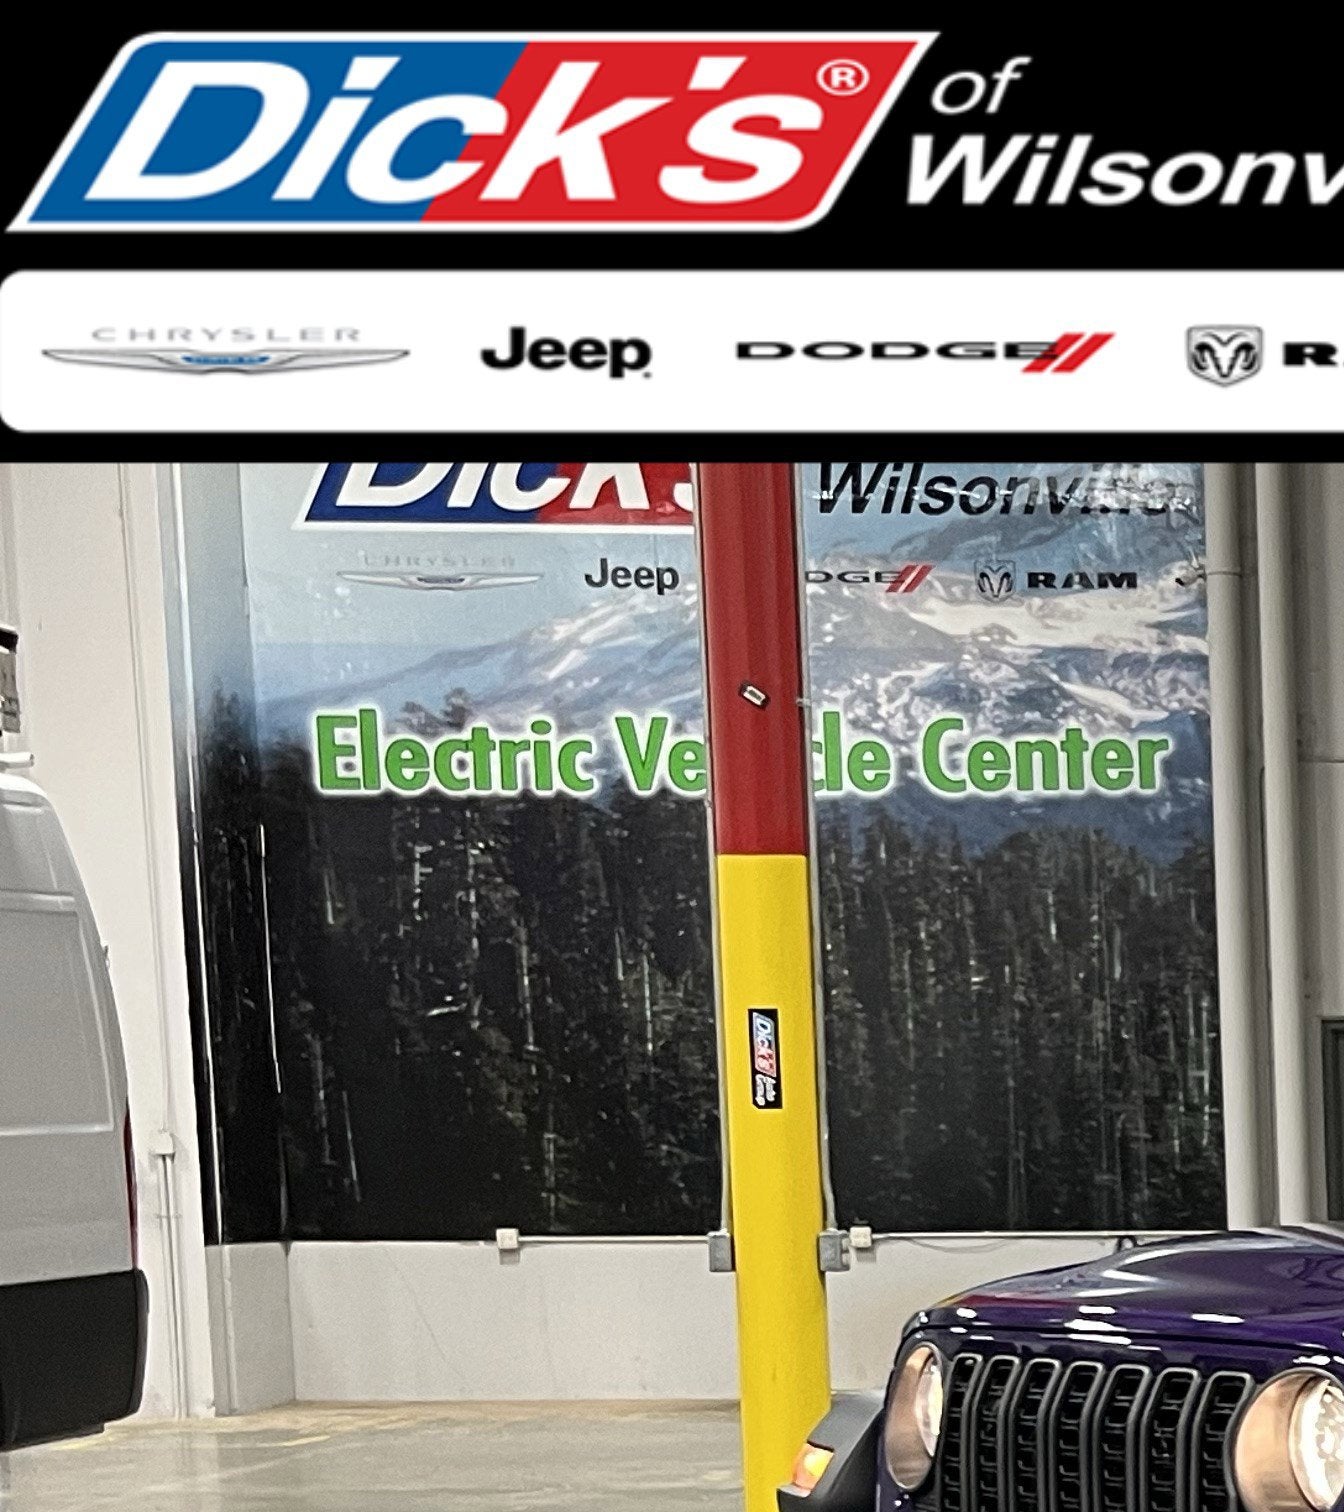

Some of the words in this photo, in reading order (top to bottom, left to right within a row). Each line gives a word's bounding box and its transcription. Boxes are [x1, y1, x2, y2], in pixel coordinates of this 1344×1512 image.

[818, 463, 1168, 515] Wilsonv
[584, 557, 680, 595] Jeep
[804, 570, 904, 583] DGE
[1027, 571, 1138, 590] RAM
[316, 709, 594, 791] Electric
[615, 711, 890, 792] Vele
[923, 718, 1169, 791] Center
